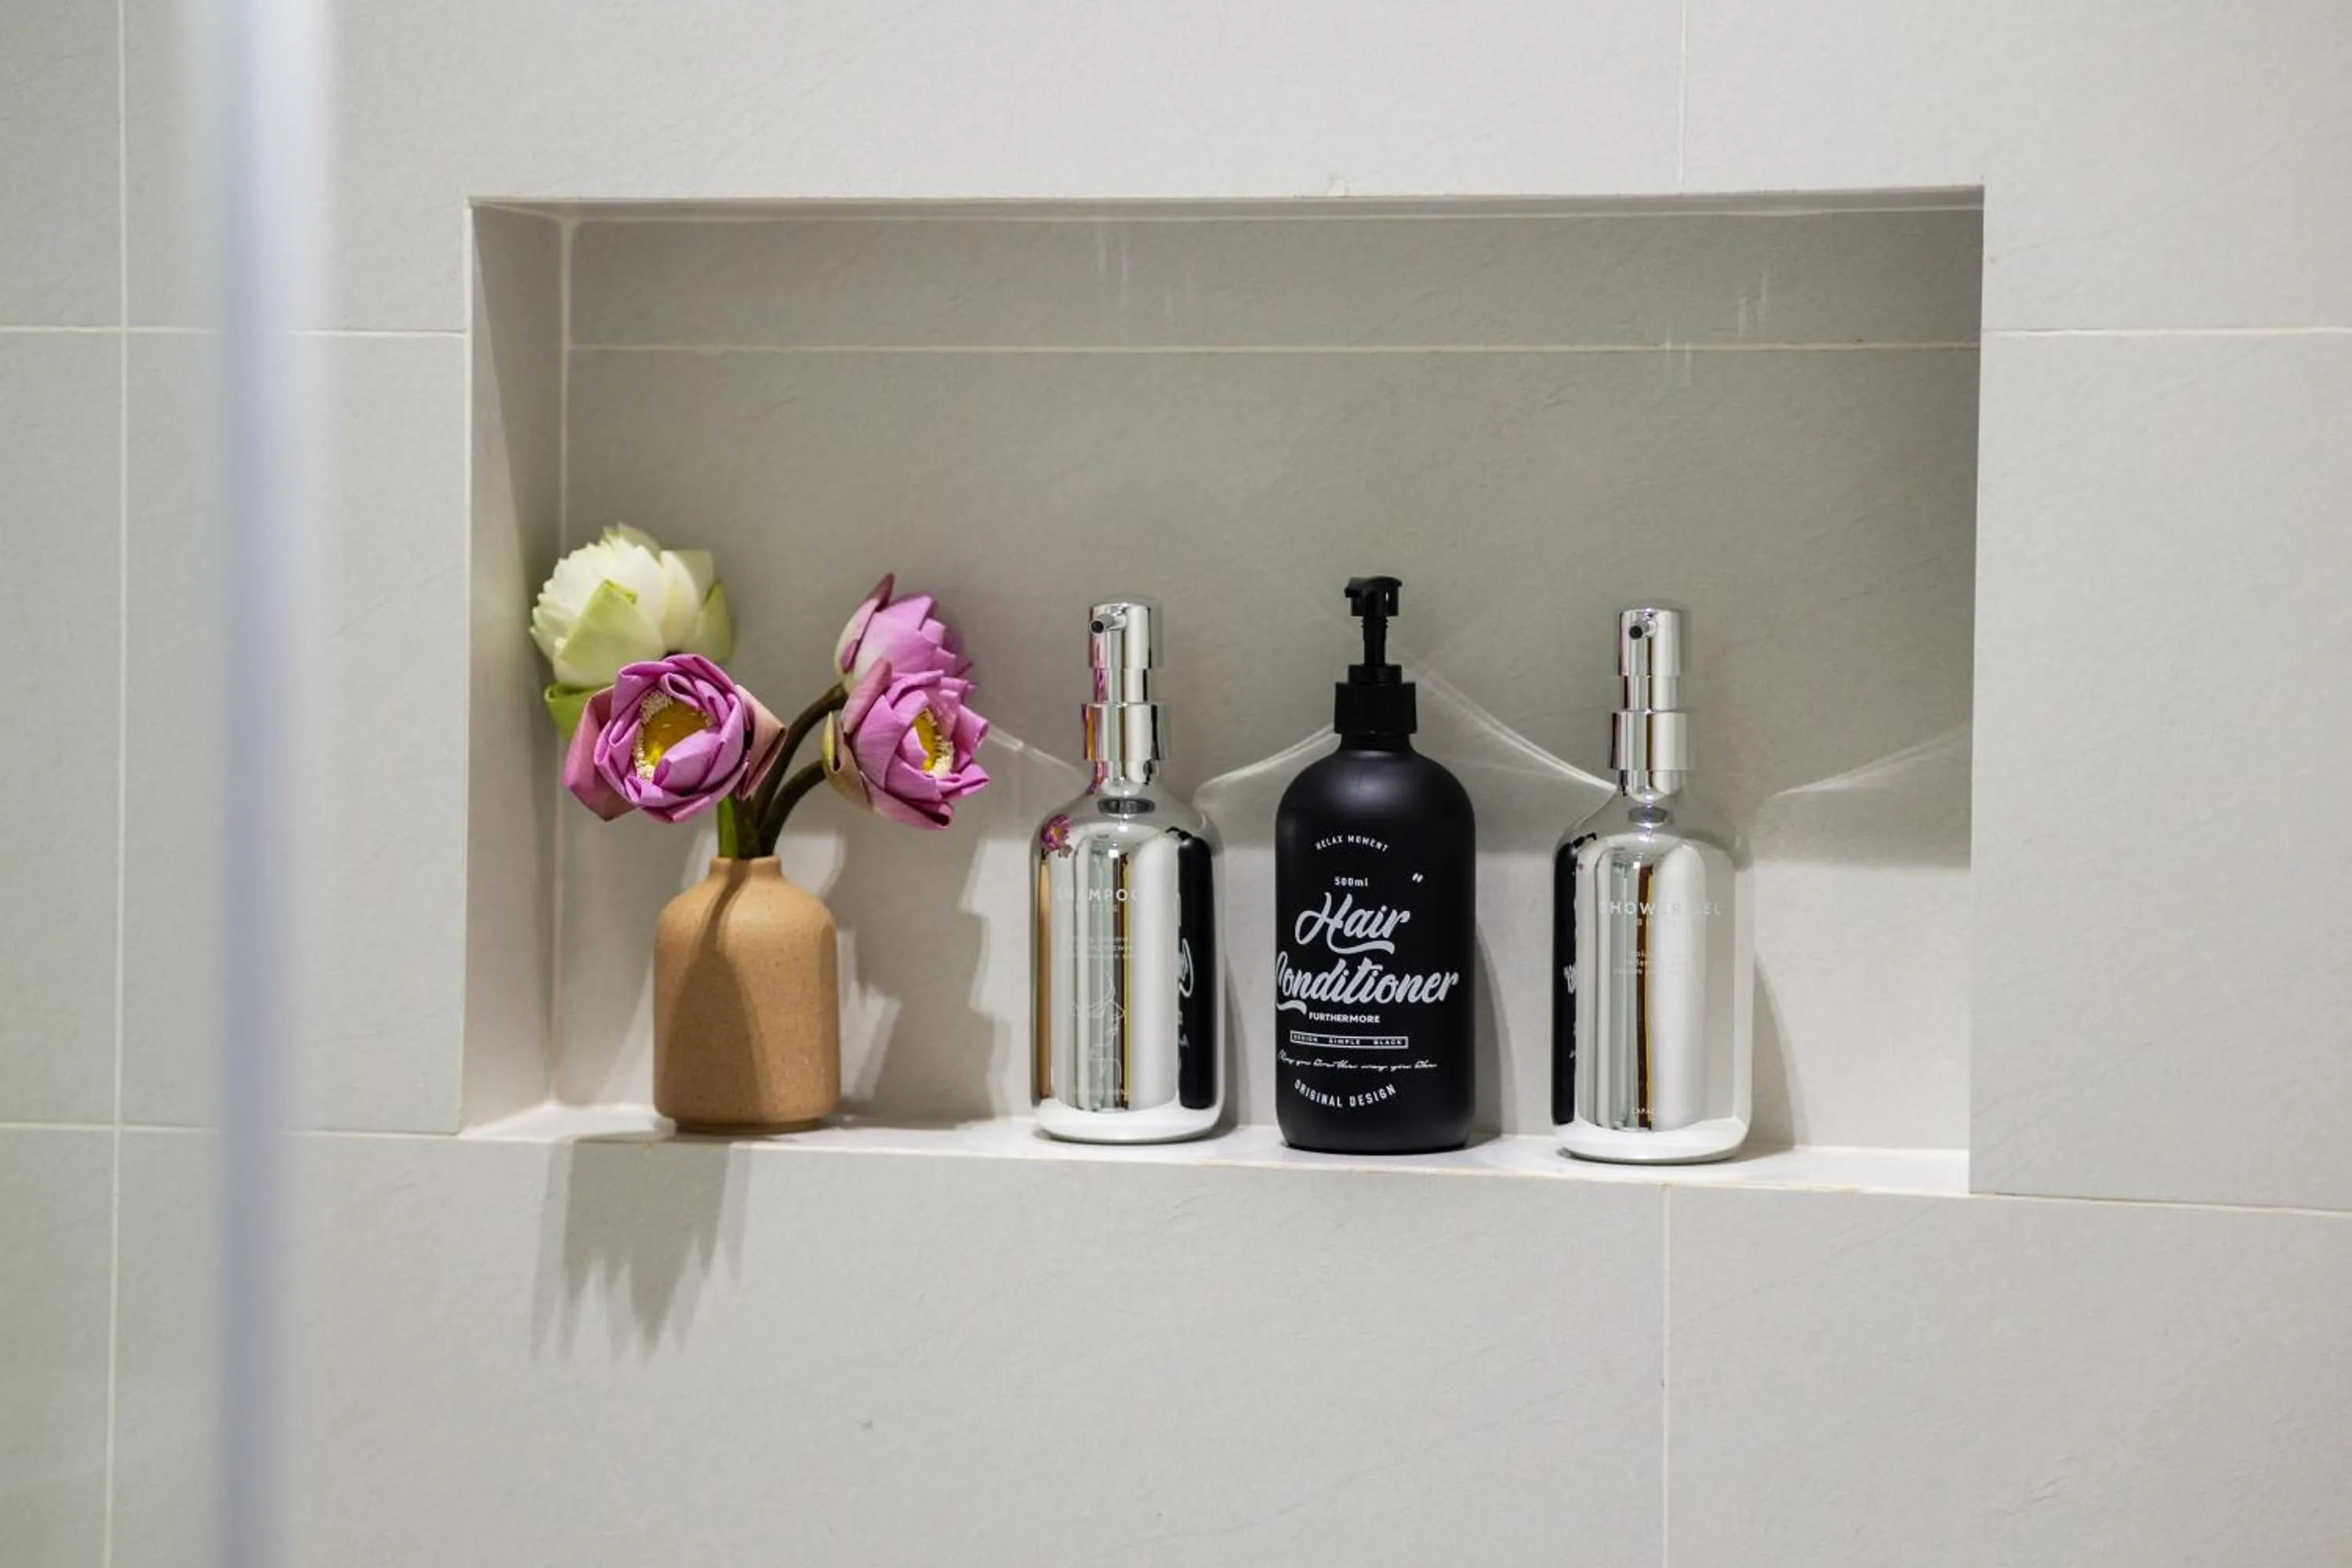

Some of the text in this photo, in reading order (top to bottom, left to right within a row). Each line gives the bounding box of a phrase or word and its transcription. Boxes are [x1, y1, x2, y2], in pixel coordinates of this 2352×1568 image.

[1315, 835, 1388, 852] RELAX MOMENT
[1334, 876, 1368, 887] 500ml
[1295, 891, 1411, 955] Hair
[1308, 1012, 1381, 1023] FURTHERMORE
[1294, 1079, 1396, 1108] ORIGINAL DESIGN
